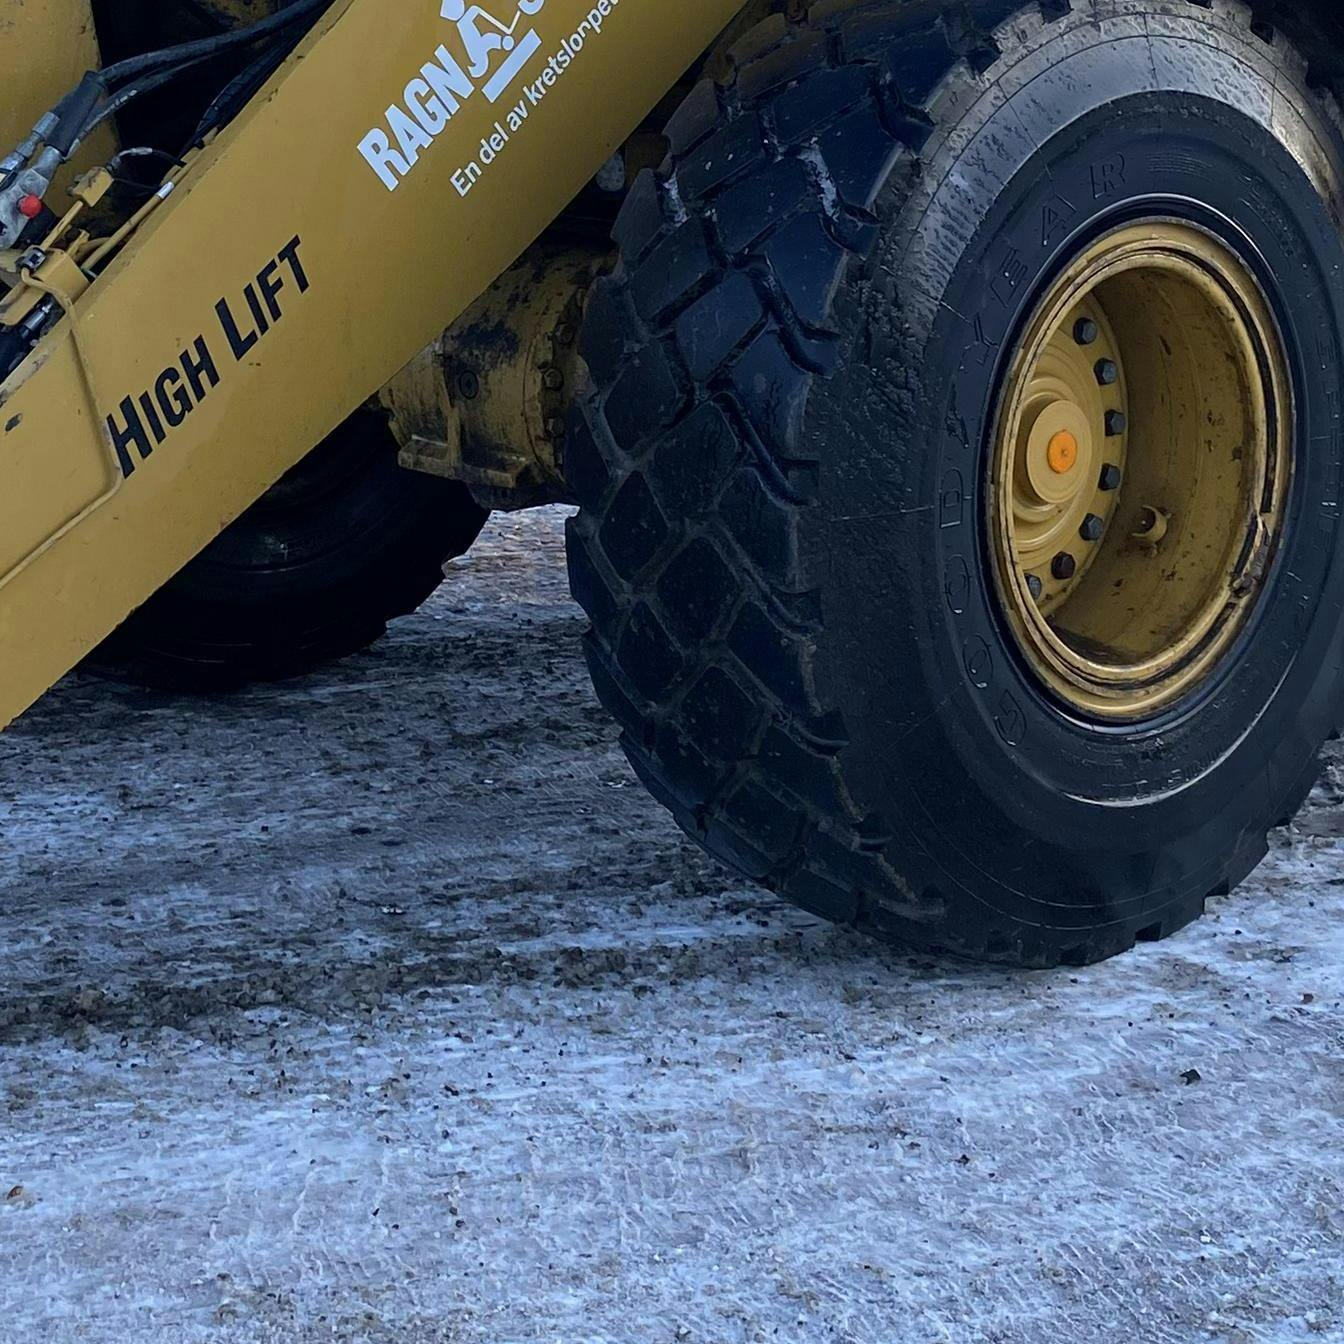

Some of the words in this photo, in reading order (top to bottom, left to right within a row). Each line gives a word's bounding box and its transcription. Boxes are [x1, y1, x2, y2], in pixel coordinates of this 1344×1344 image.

[356, 44, 475, 192] RAGN
[449, 161, 482, 198] En
[478, 121, 510, 164] del
[505, 99, 529, 133] av
[106, 334, 221, 480] HIGH
[214, 234, 310, 362] LIFT
